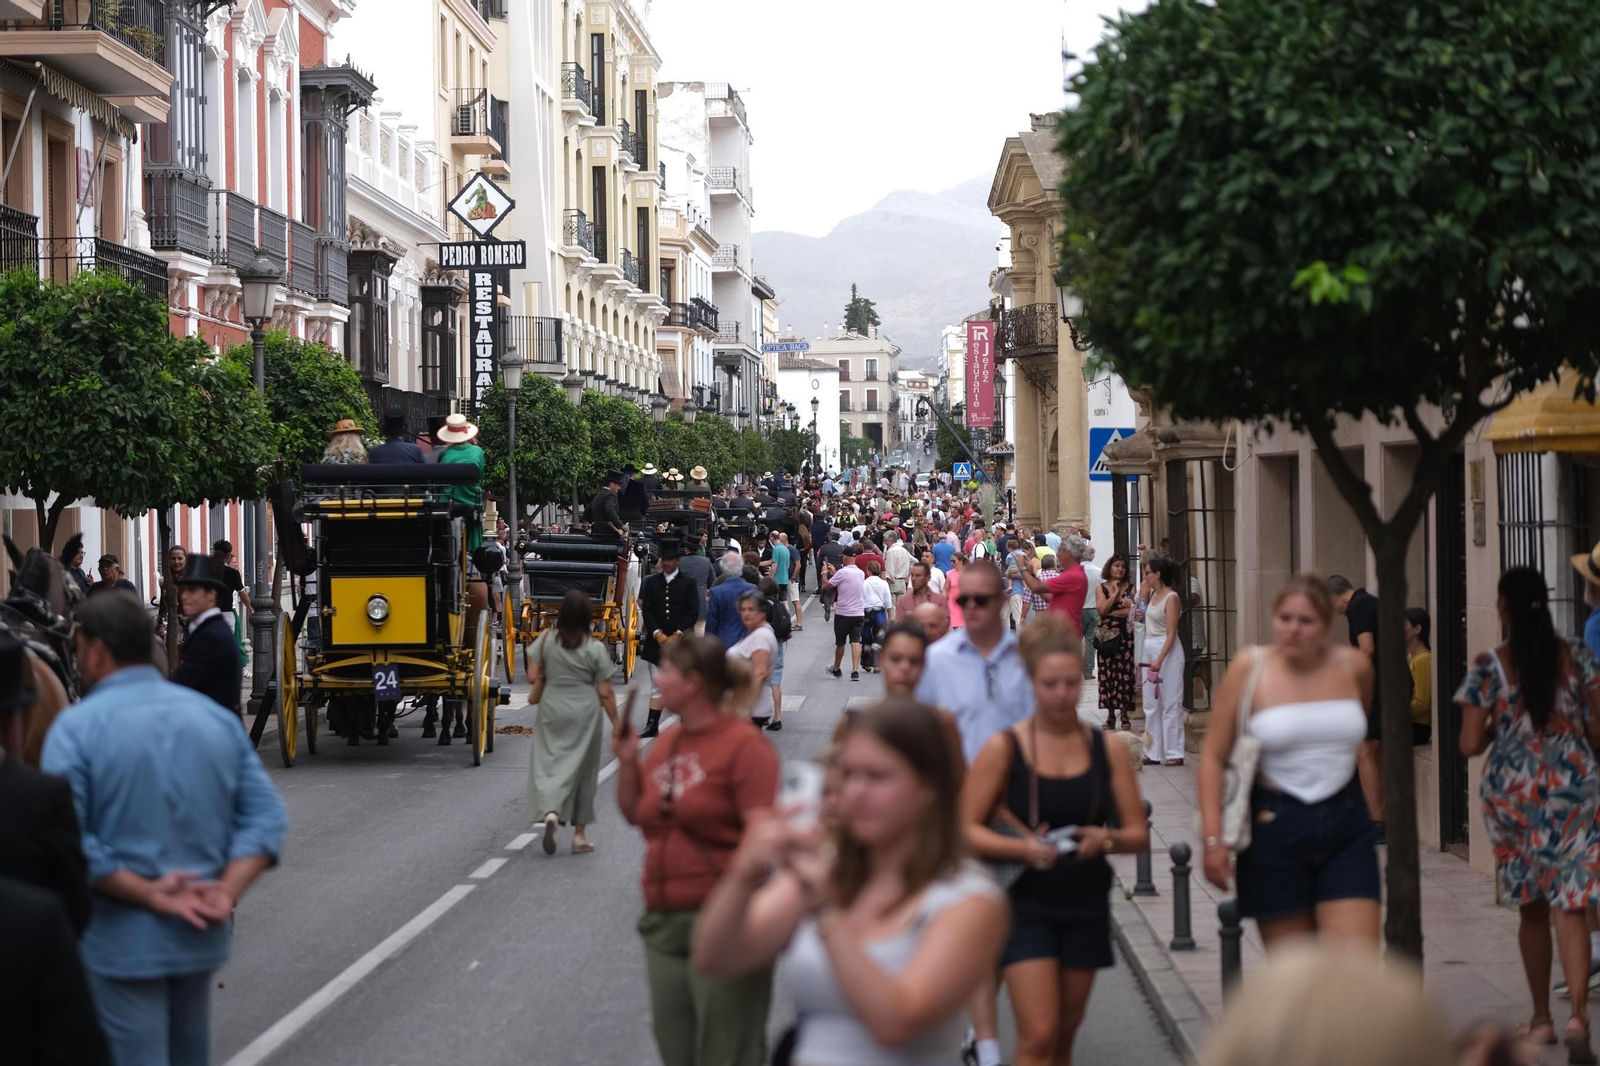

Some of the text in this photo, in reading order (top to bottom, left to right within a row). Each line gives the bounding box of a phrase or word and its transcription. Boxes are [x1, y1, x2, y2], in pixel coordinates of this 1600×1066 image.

[442, 244, 523, 266] PEDRO ROMERO
[374, 670, 398, 690] 24
